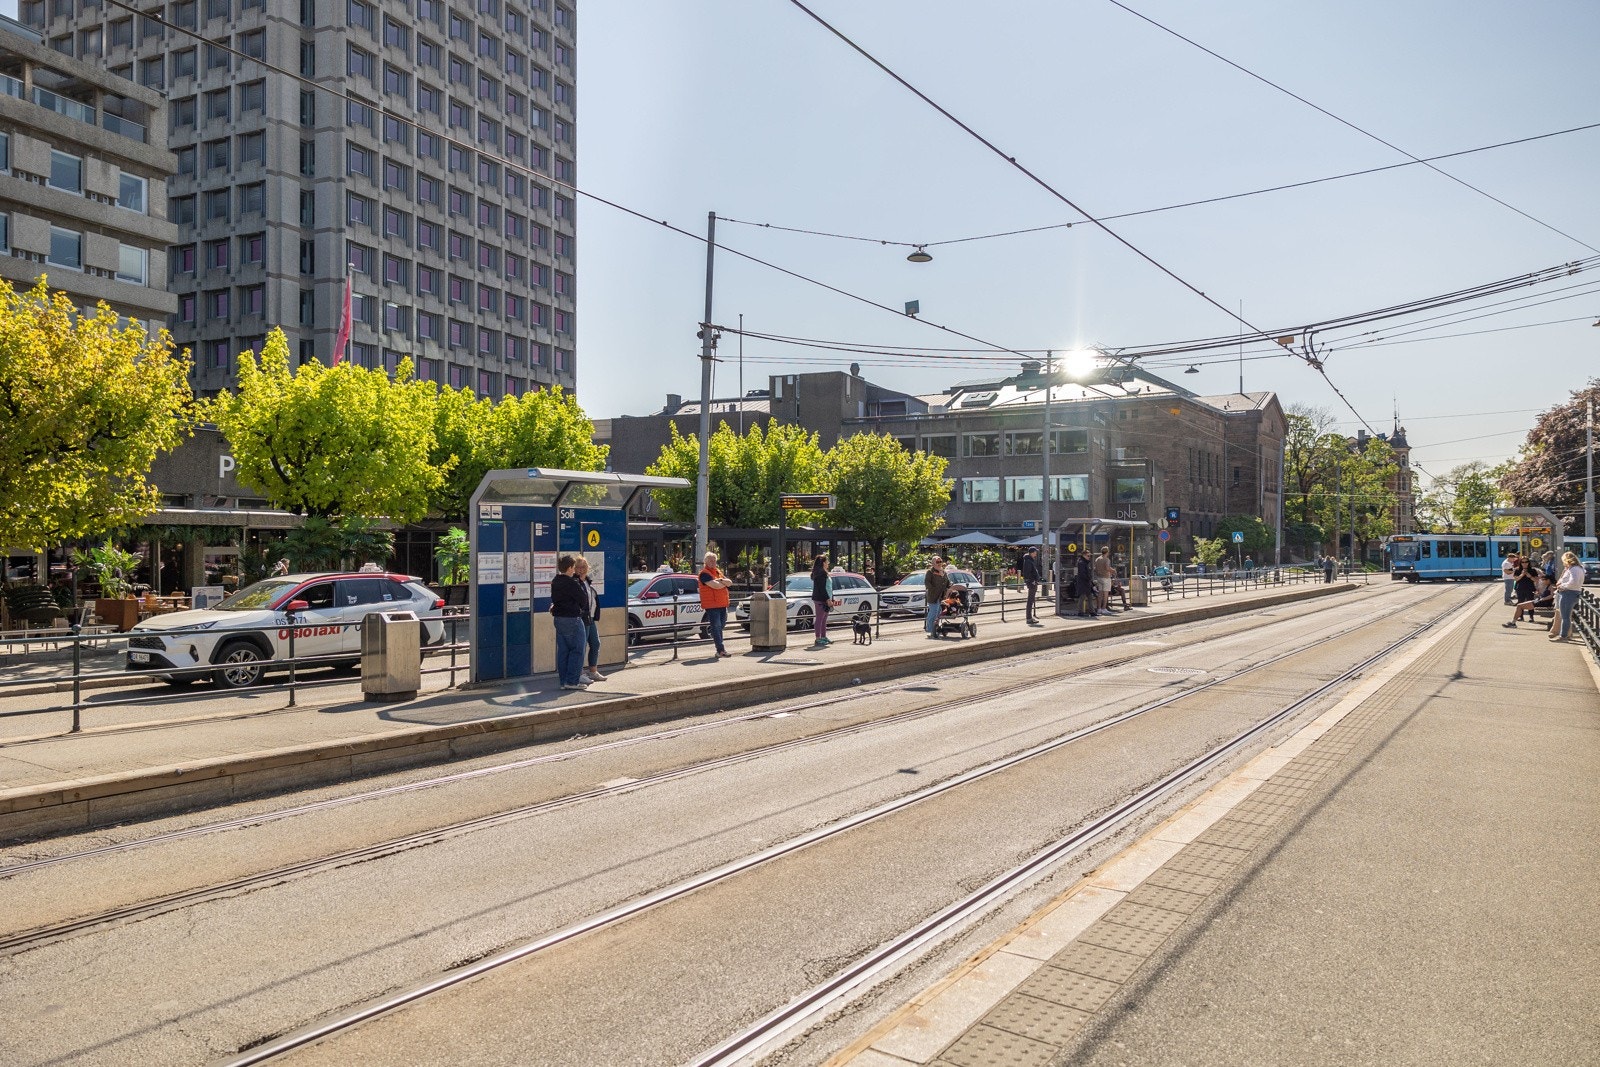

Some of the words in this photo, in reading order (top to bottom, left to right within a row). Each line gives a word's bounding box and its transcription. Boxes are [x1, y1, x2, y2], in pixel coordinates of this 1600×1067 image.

[219, 455, 235, 478] P
[560, 509, 575, 519] Solli
[1117, 504, 1137, 520] DNB
[590, 533, 597, 543] A
[644, 607, 675, 619] OsloTax
